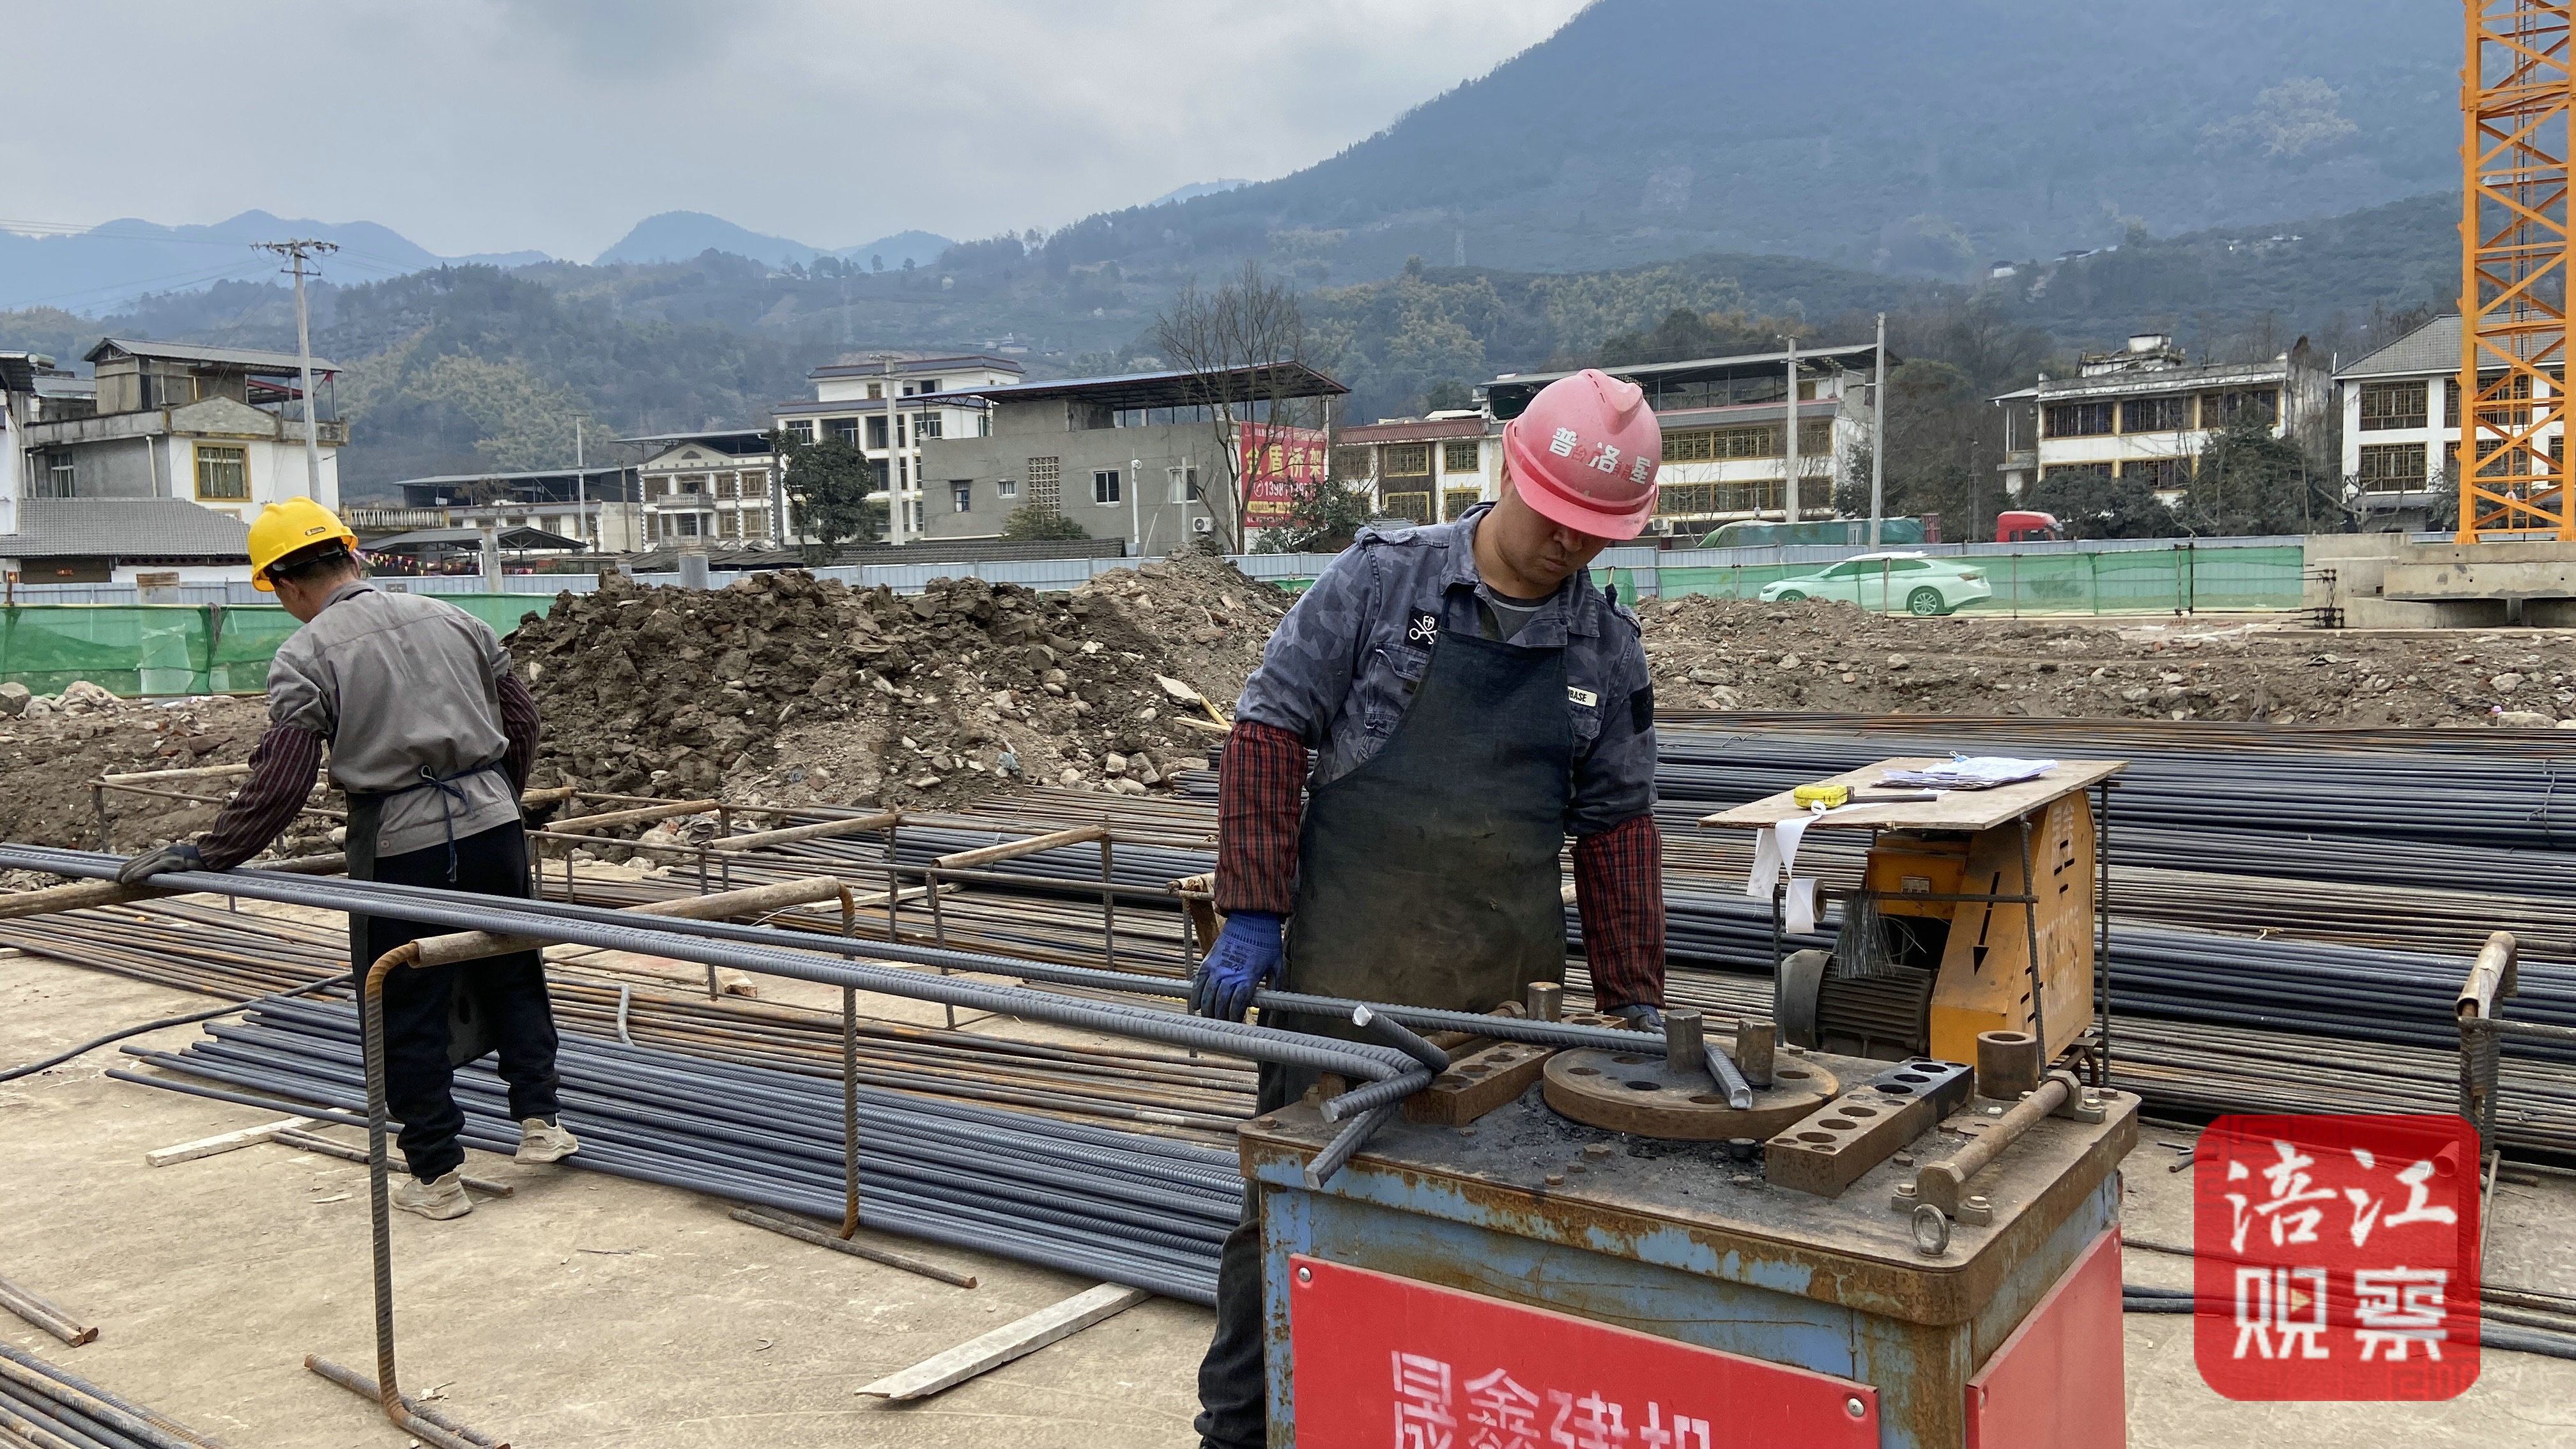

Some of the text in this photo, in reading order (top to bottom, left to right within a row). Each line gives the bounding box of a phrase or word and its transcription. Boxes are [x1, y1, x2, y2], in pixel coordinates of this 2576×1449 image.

[1245, 443, 1322, 478] 金盾桥架
[1549, 427, 1651, 484] 普洛星
[1568, 689, 1587, 702] BASE
